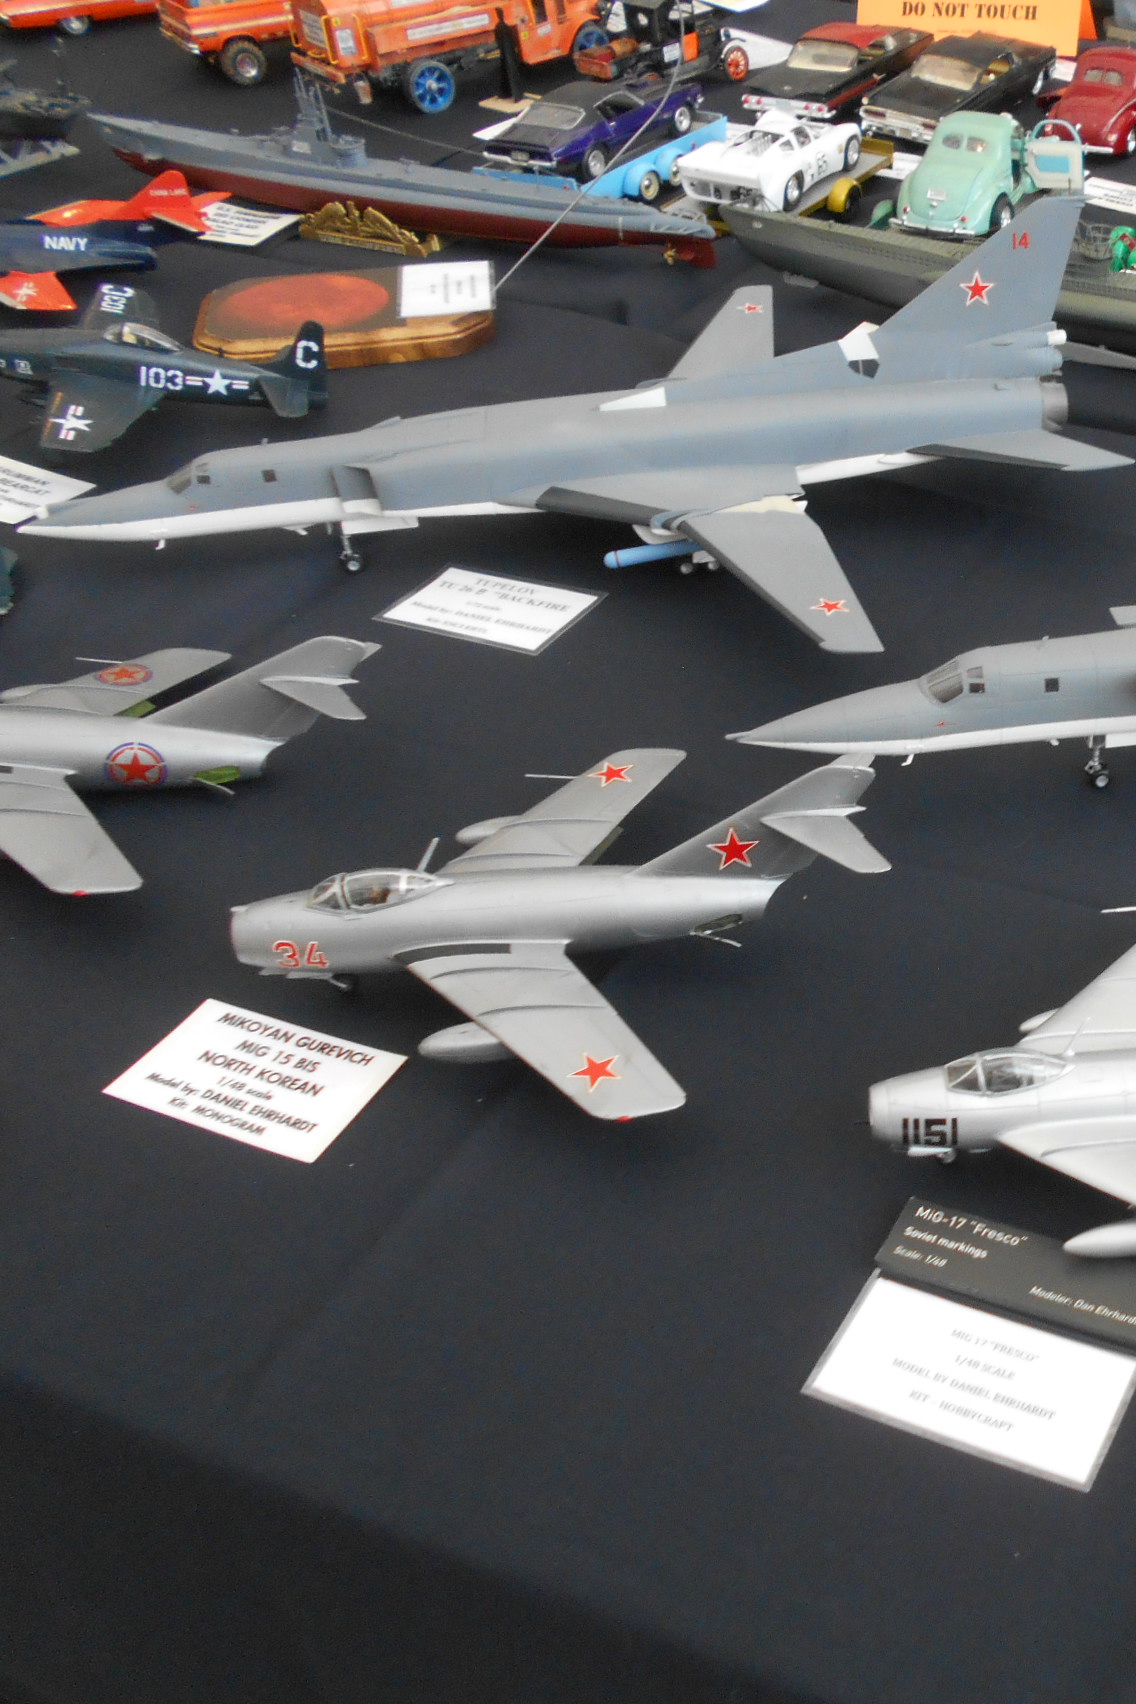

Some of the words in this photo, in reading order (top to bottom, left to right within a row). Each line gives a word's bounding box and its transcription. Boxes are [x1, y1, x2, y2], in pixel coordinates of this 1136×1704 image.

[902, 2, 926, 16] DO
[932, 3, 968, 18] NOT
[975, 4, 1038, 20] TOUCH
[44, 235, 88, 251] NAVY
[1013, 232, 1030, 250] 14
[295, 340, 320, 369] C
[140, 366, 184, 391] 103
[272, 940, 329, 968] 34
[216, 1012, 295, 1044] MIKOYAN
[295, 1036, 376, 1068] GUREVICH
[234, 1039, 272, 1059] MIG
[273, 1050, 291, 1066] 15
[293, 1056, 322, 1074] BIS
[198, 1050, 256, 1075] NORTH
[256, 1067, 326, 1098] KOREAN
[145, 1072, 182, 1090] Model
[183, 1082, 201, 1098] by:
[201, 1088, 250, 1112] DANIEL
[250, 1104, 320, 1134] EHRHARDT
[216, 1076, 243, 1094] 1/48
[245, 1084, 274, 1102] scale
[192, 1104, 267, 1136] MONOGRAM
[902, 1118, 958, 1146] 1151
[914, 1205, 966, 1230] MiG-17
[970, 1219, 1030, 1248] "Fresco"
[903, 1226, 938, 1245] Soviet
[937, 1234, 990, 1260] markings
[1074, 1298, 1096, 1314] Dan
[981, 1362, 1016, 1381] SCALE
[891, 1357, 932, 1380] MODEL
[933, 1372, 949, 1385] BY
[949, 1378, 992, 1401] DANIEL
[992, 1392, 1057, 1422] EHRHARDT
[909, 1389, 931, 1404] KIT
[939, 1400, 1015, 1434] HOBBYCRAFT
